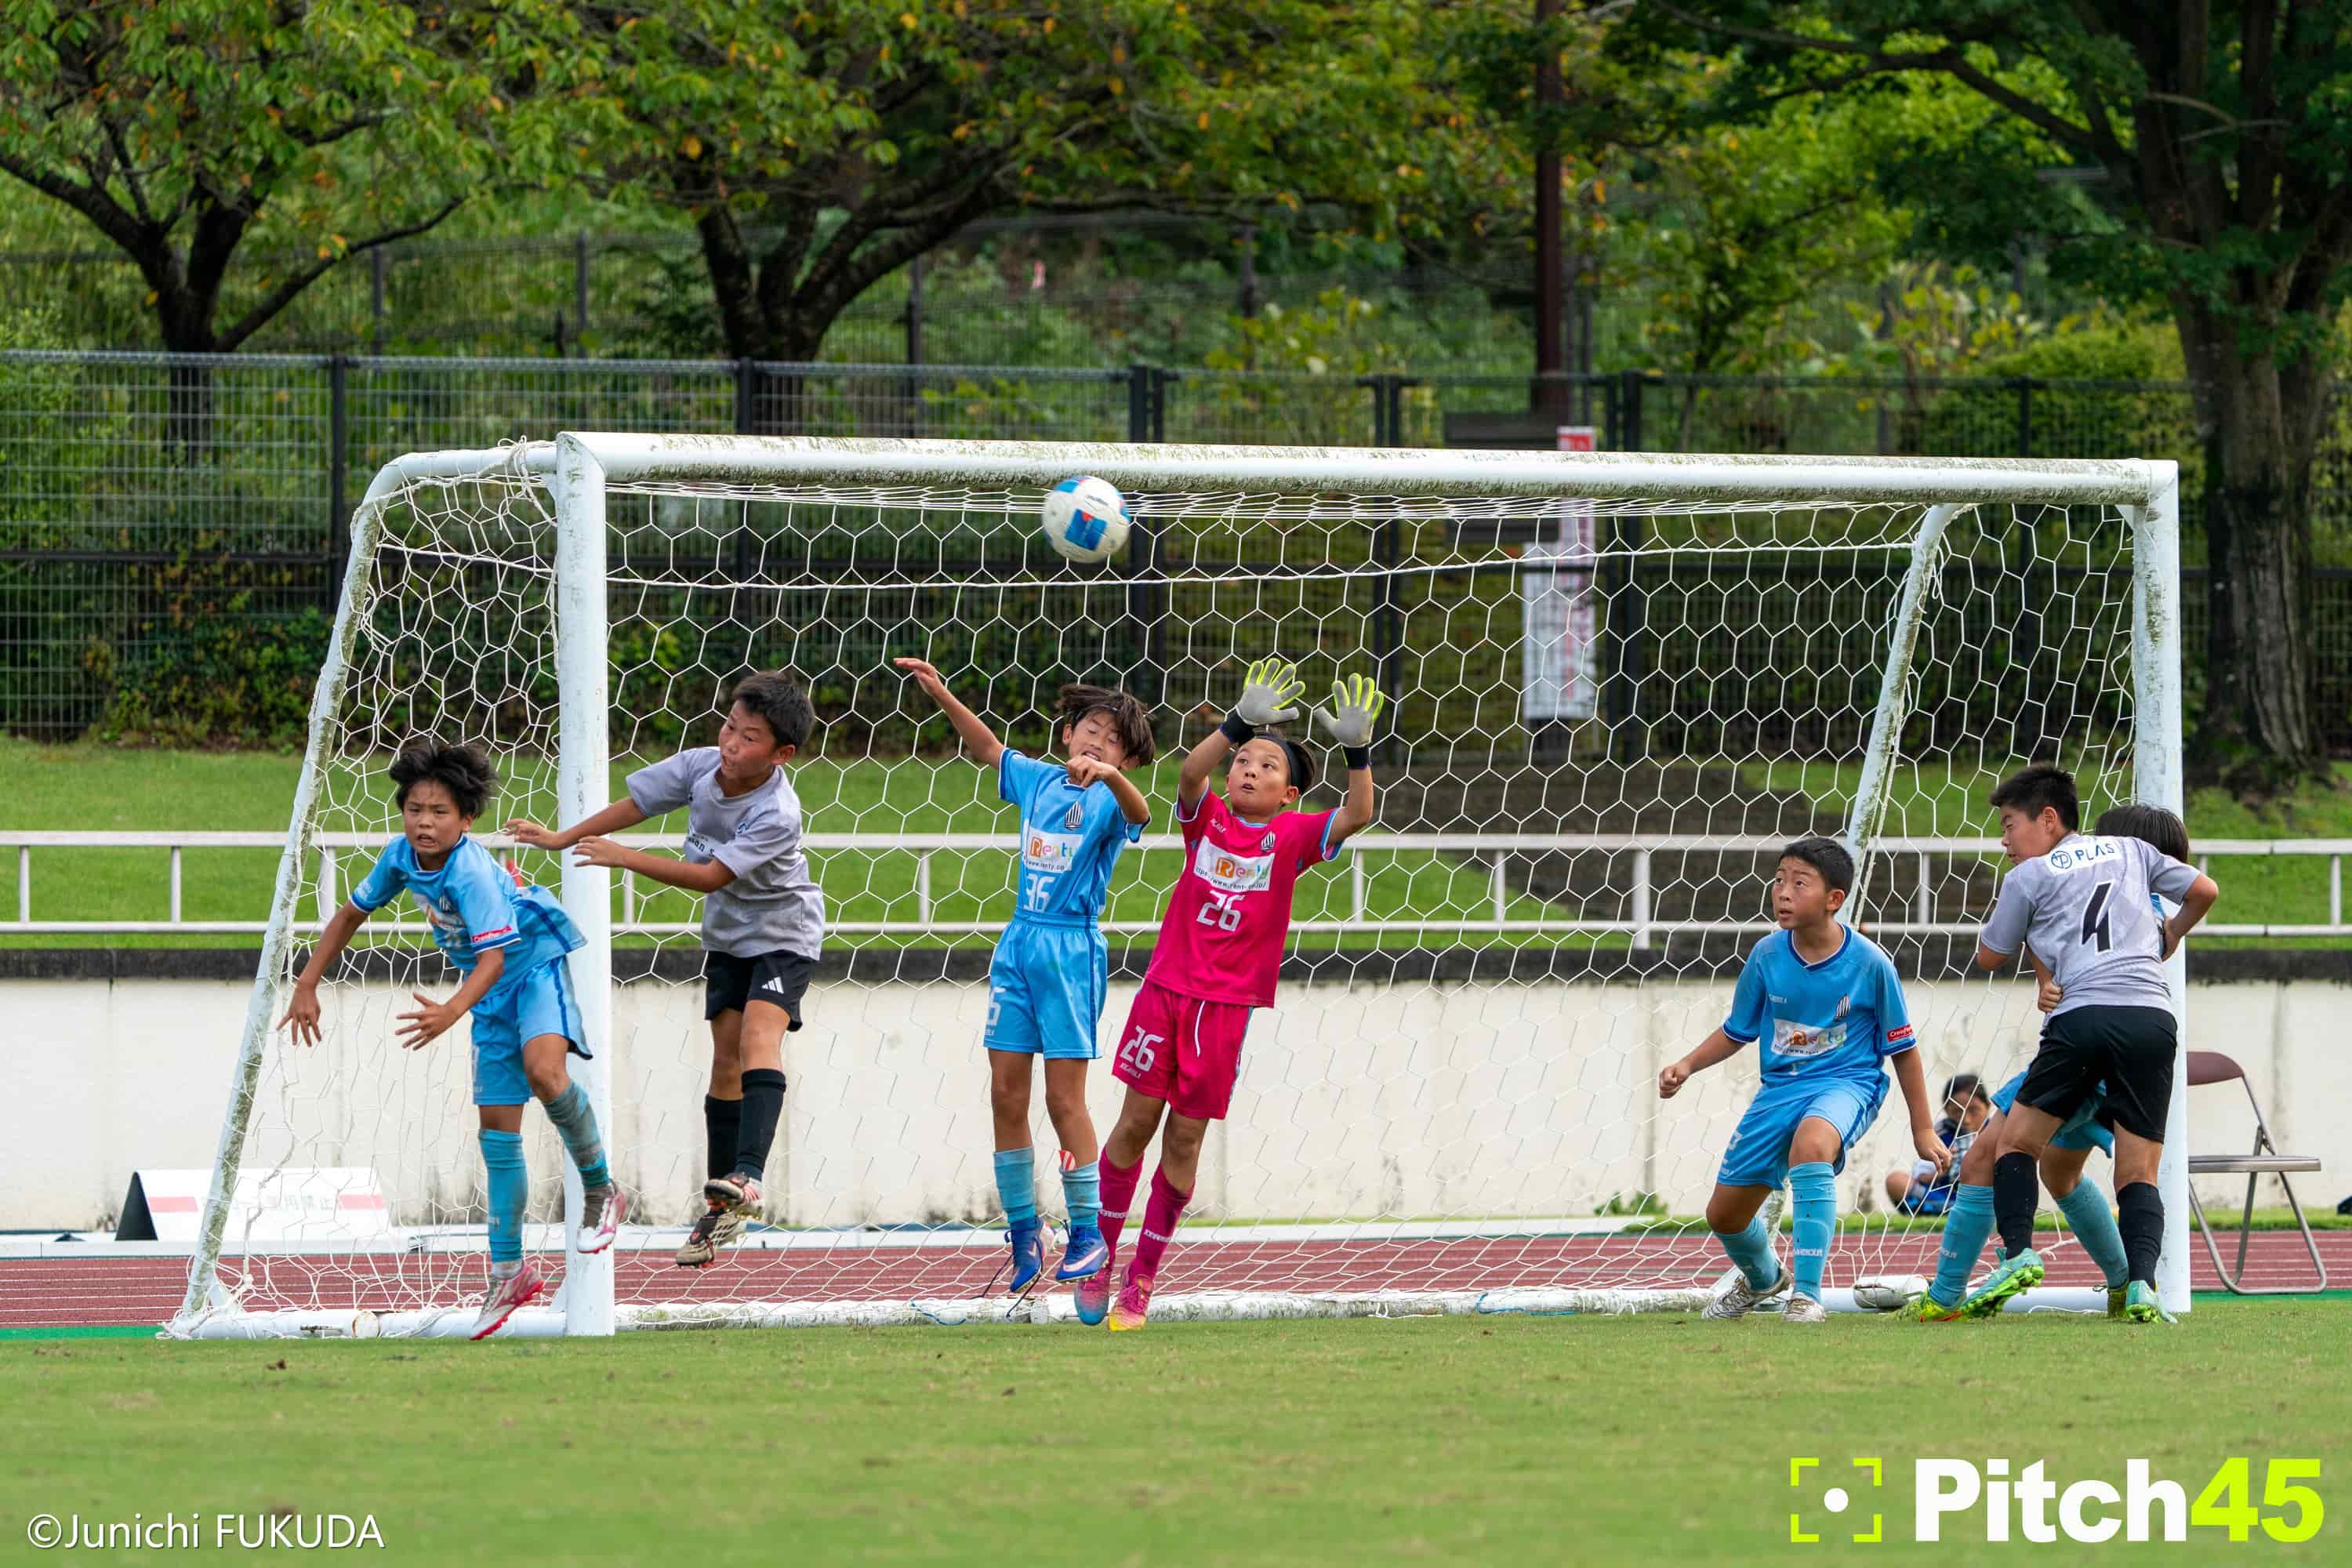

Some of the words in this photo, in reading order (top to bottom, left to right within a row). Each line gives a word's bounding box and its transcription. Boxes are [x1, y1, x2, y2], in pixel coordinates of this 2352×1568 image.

[2075, 843, 2115, 862] PLAS
[1023, 873, 1055, 913] 36
[1196, 890, 1245, 932] 26
[2081, 879, 2115, 953] 4
[1119, 1025, 1165, 1073] 26
